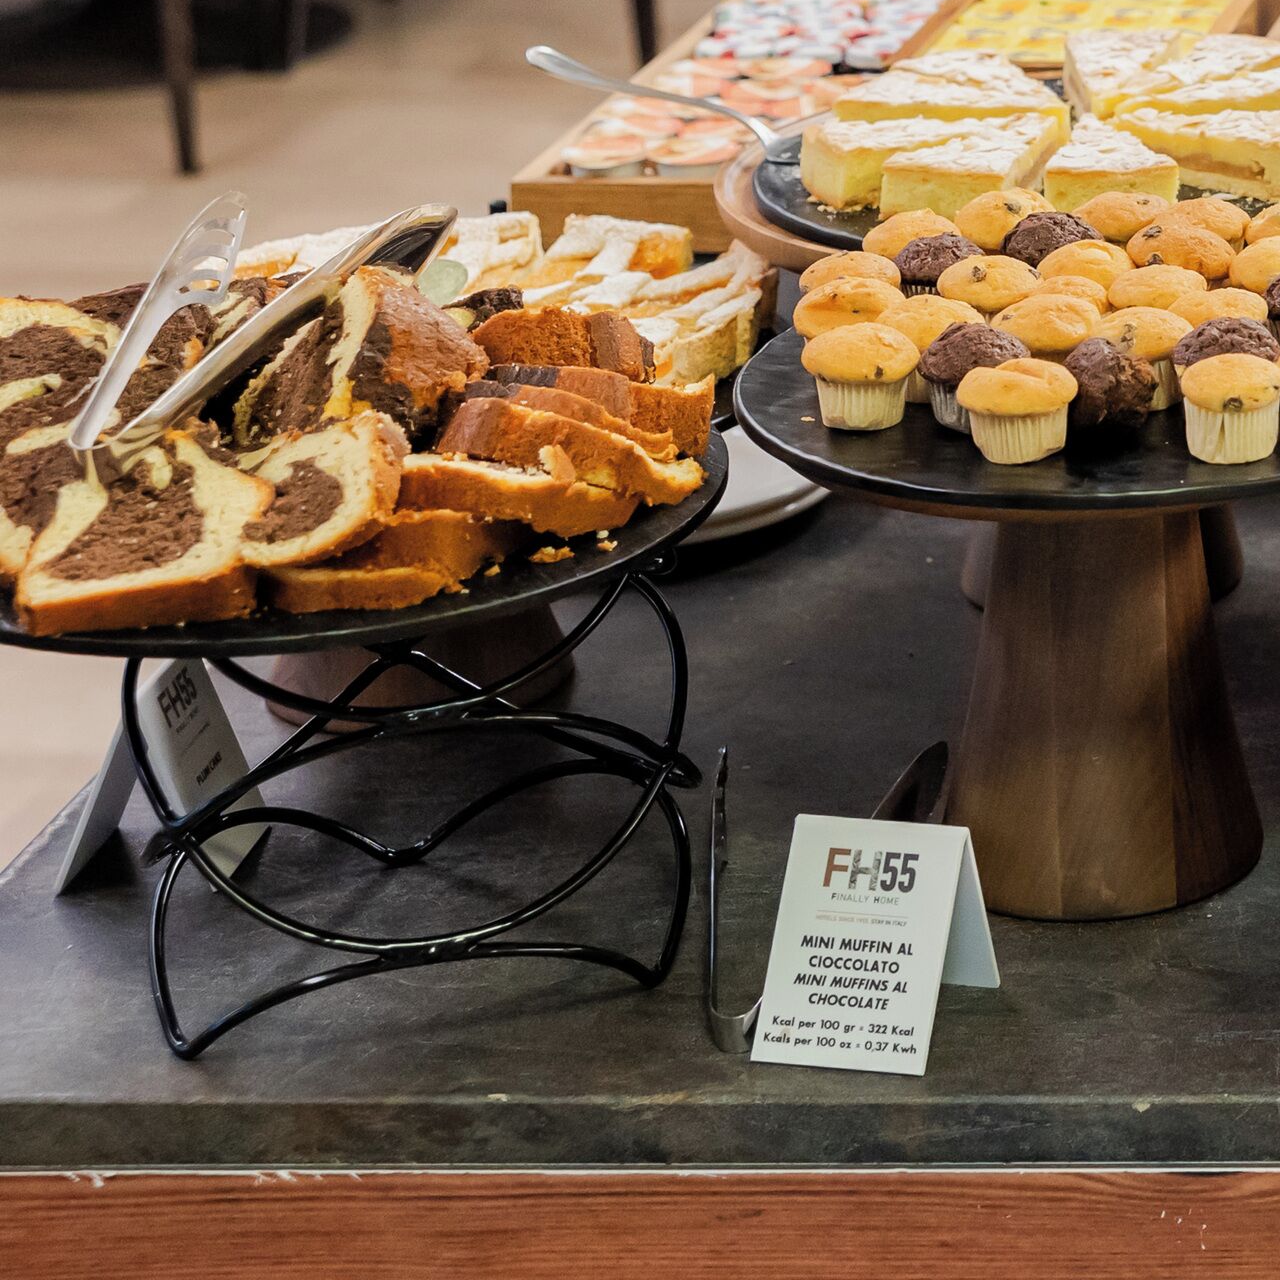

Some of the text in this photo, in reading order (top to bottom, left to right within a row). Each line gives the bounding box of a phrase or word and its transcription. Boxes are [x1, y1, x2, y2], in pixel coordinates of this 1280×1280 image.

[157, 666, 197, 728] FH55
[823, 847, 920, 894] FH55
[831, 892, 901, 906] FINALLY HOME
[801, 935, 913, 956] MINI MUFFIN AL
[808, 955, 900, 974] CIOCCOLATO
[793, 973, 908, 993] MINI MUFFINS AL
[808, 993, 890, 1010] CHOCOLATE
[772, 1015, 796, 1027] Kcal
[798, 1021, 817, 1029] per
[820, 1019, 840, 1030] 100
[843, 1025, 856, 1034] gr
[868, 1024, 888, 1035] 322
[891, 1025, 915, 1037] Kcal
[763, 1032, 791, 1044] Kcals
[794, 1037, 812, 1047] per
[816, 1036, 836, 1047] 100
[864, 1040, 889, 1053] 0,37
[892, 1042, 917, 1055] Kwh
